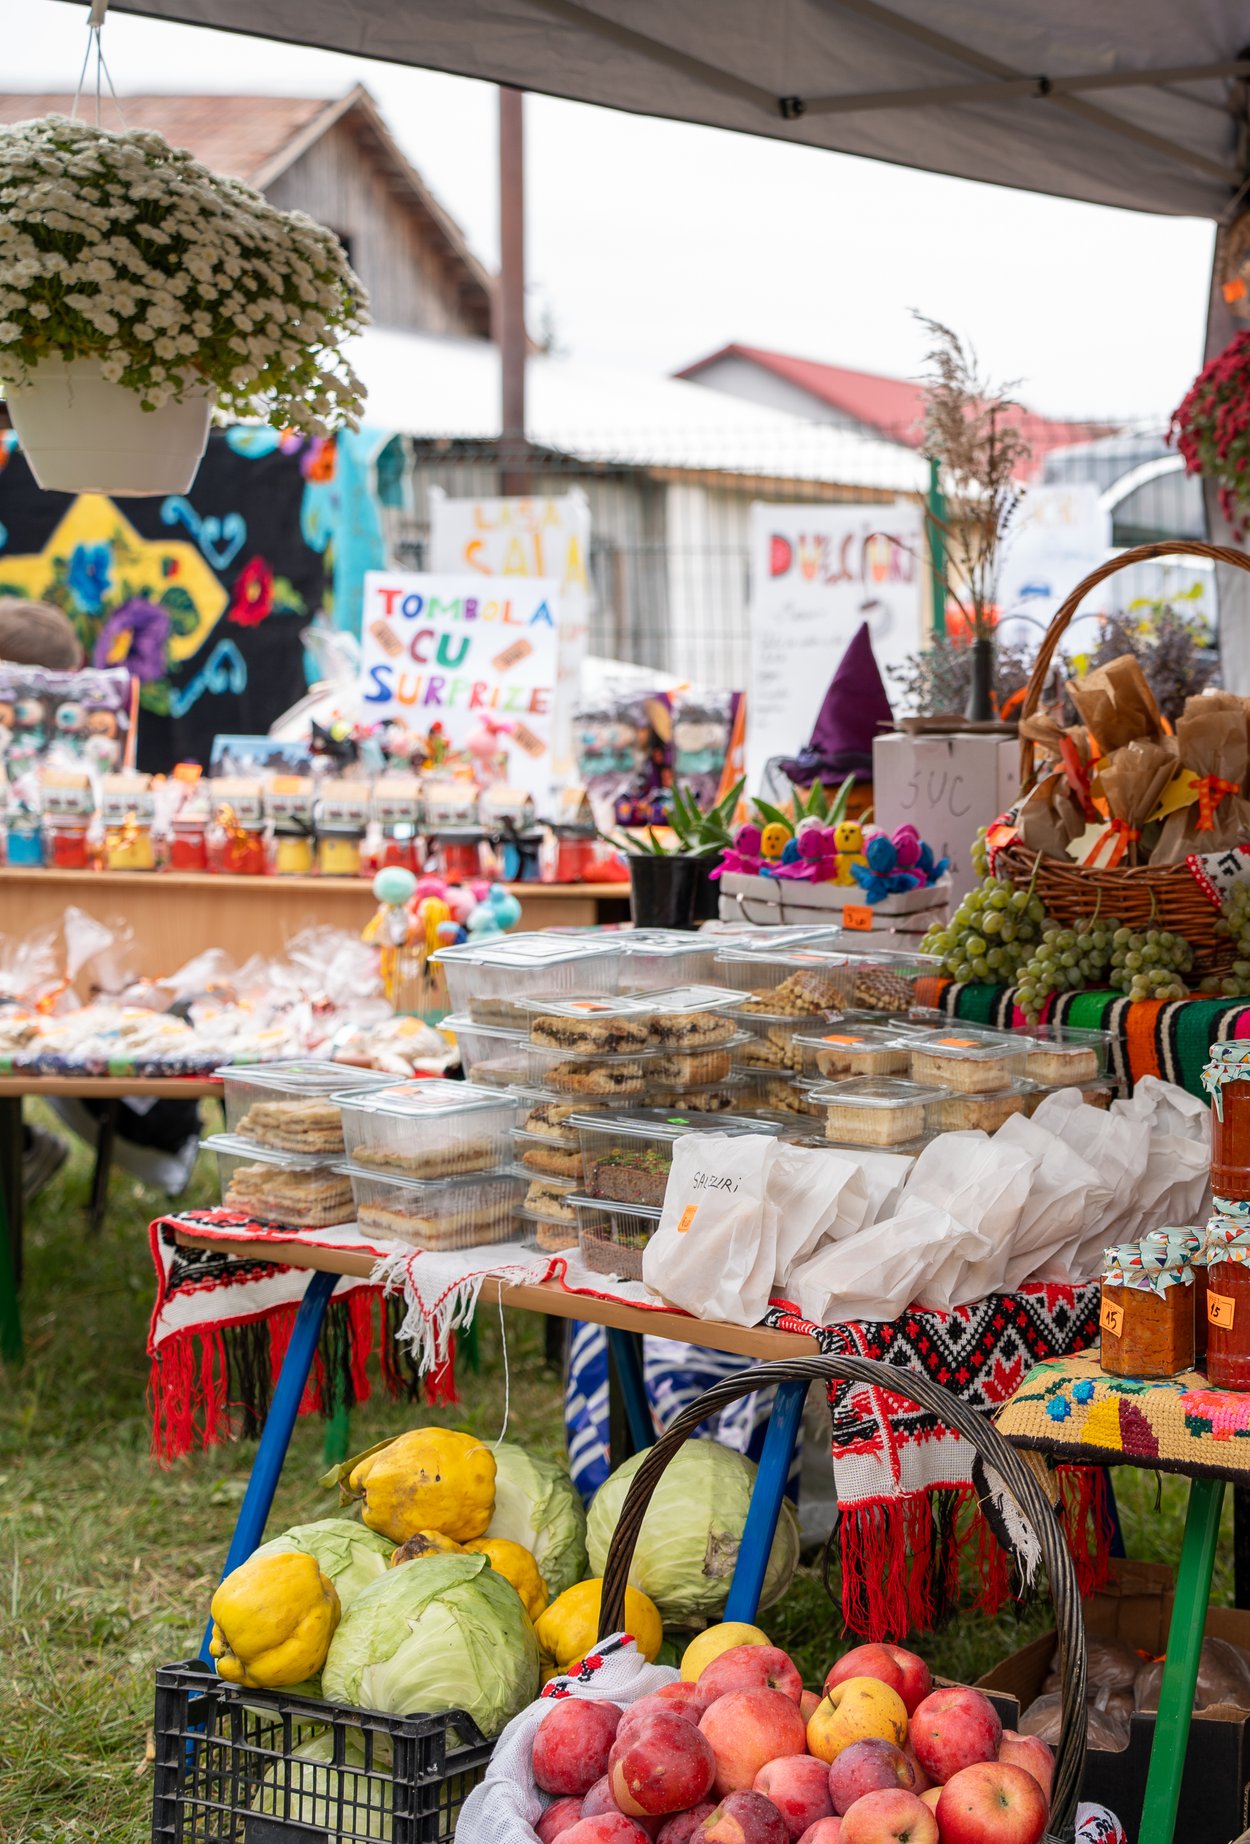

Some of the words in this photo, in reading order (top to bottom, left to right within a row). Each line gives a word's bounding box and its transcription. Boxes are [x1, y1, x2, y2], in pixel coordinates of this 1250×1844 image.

[377, 588, 554, 627] TOMBOLA
[409, 629, 470, 668] CU
[364, 665, 552, 714] SURPRIZE
[901, 771, 971, 817] SUC
[1106, 1311, 1118, 1330] 15
[1210, 1303, 1221, 1318] 15
